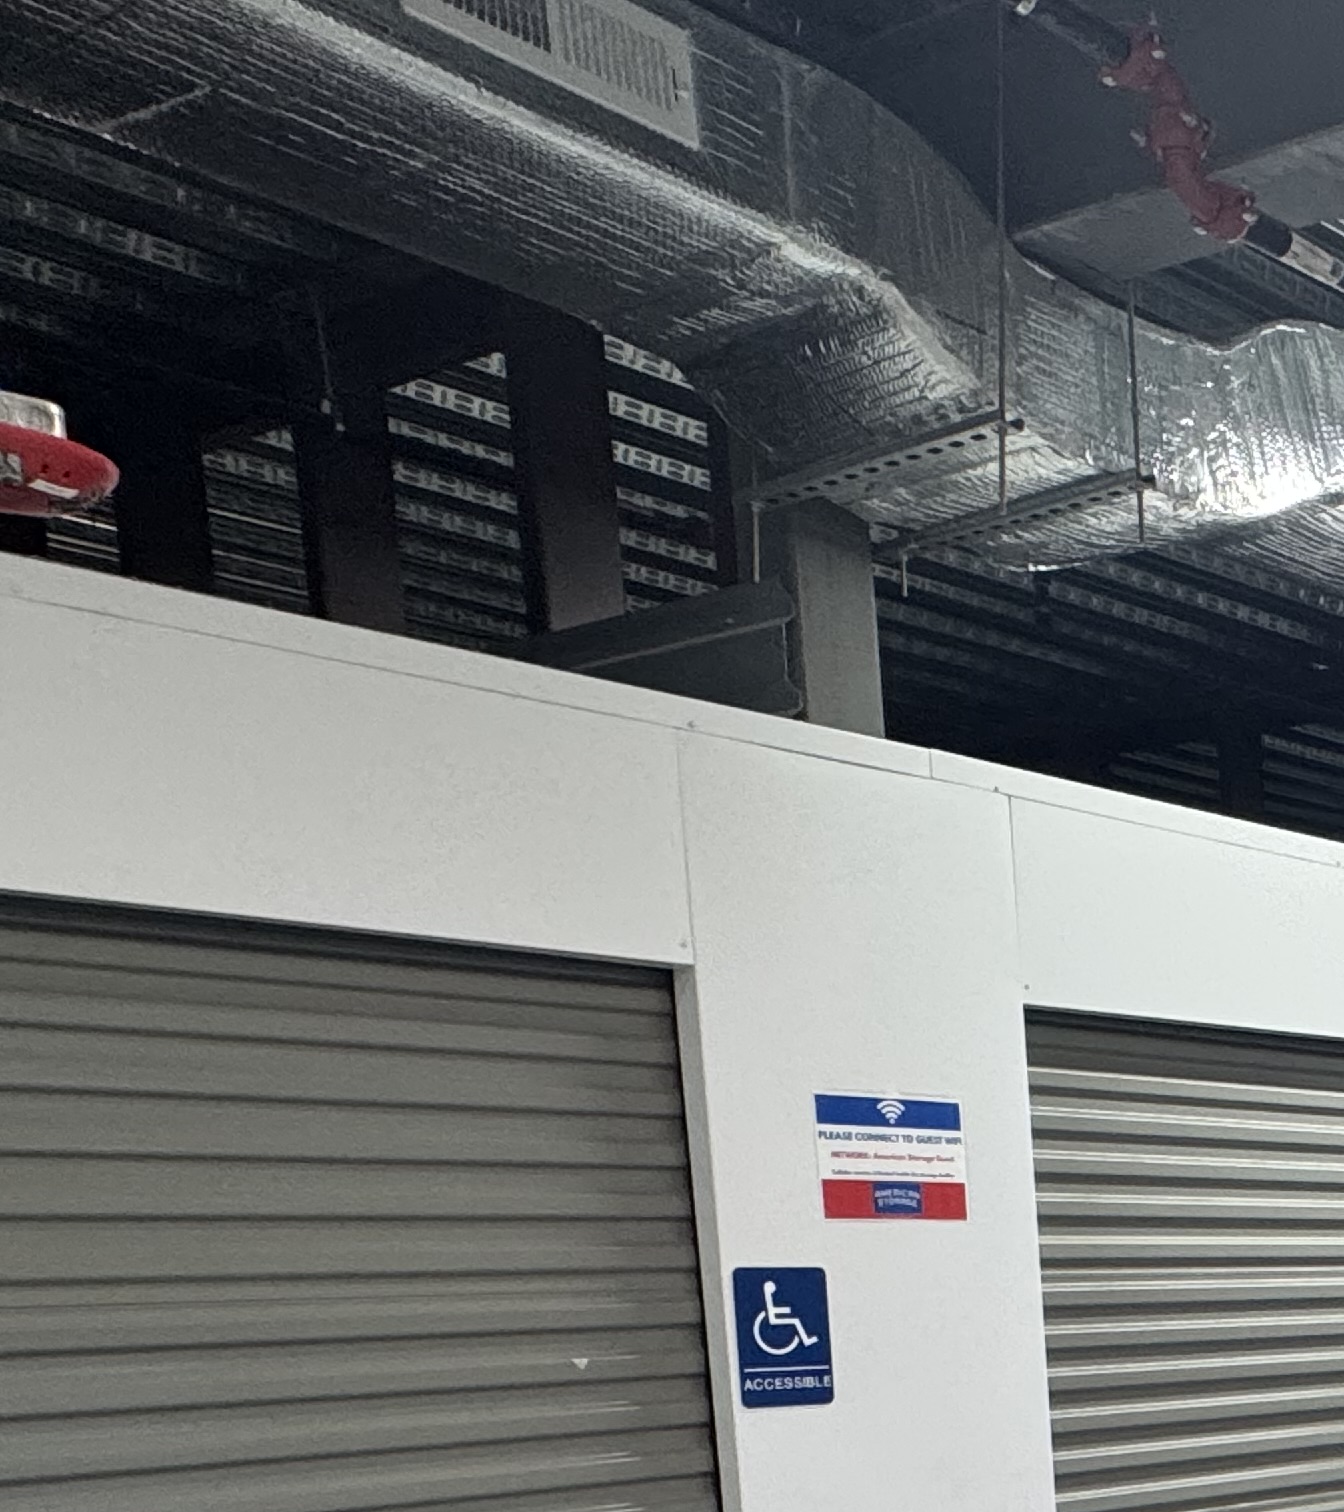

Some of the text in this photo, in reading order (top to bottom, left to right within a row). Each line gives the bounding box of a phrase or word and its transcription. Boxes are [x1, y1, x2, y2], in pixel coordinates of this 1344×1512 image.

[818, 1131, 852, 1141] PLEASE
[854, 1132, 899, 1142] CONNECT
[901, 1134, 914, 1144] TO
[915, 1135, 942, 1144] GUEST
[744, 1375, 831, 1391] ACCESSIBLE
